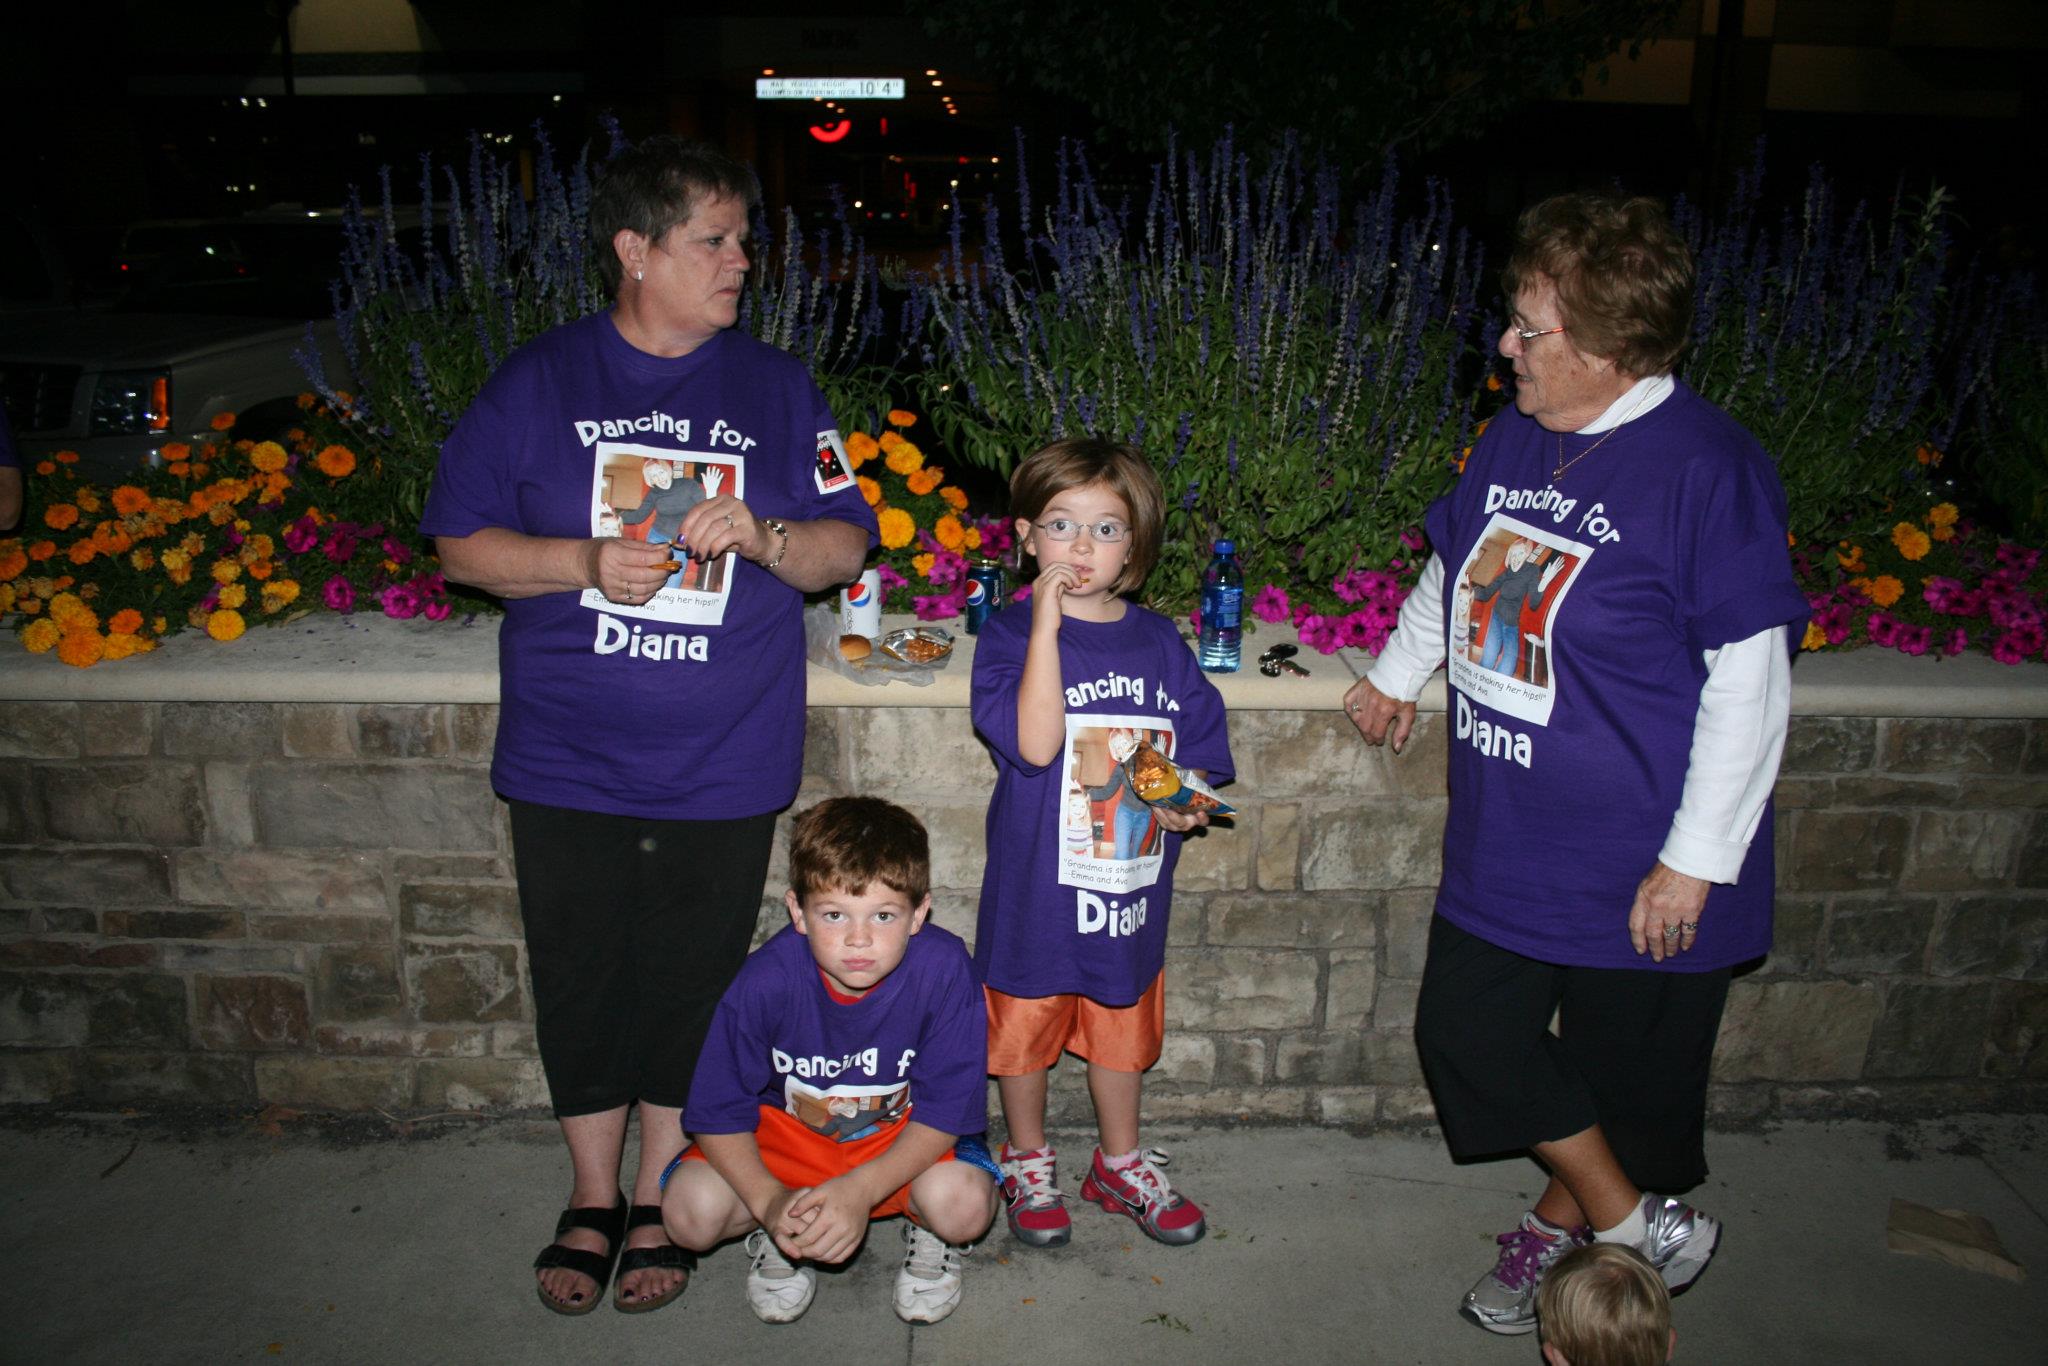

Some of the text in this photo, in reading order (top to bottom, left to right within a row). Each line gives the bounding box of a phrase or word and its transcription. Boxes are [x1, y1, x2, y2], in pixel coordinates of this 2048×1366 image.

[574, 411, 757, 451] Dancing for
[1484, 484, 1620, 544] Dancing for
[677, 594, 692, 604] her
[594, 613, 709, 662] Diana
[1063, 671, 1145, 708] ancing
[1479, 674, 1504, 692] shaking
[1506, 682, 1522, 695] her
[1456, 691, 1532, 769] Diana
[1096, 876, 1112, 885] and
[1113, 877, 1128, 886] Ava
[1105, 866, 1112, 874] is
[1077, 889, 1147, 938] Diana
[772, 1047, 879, 1078] Dancing
